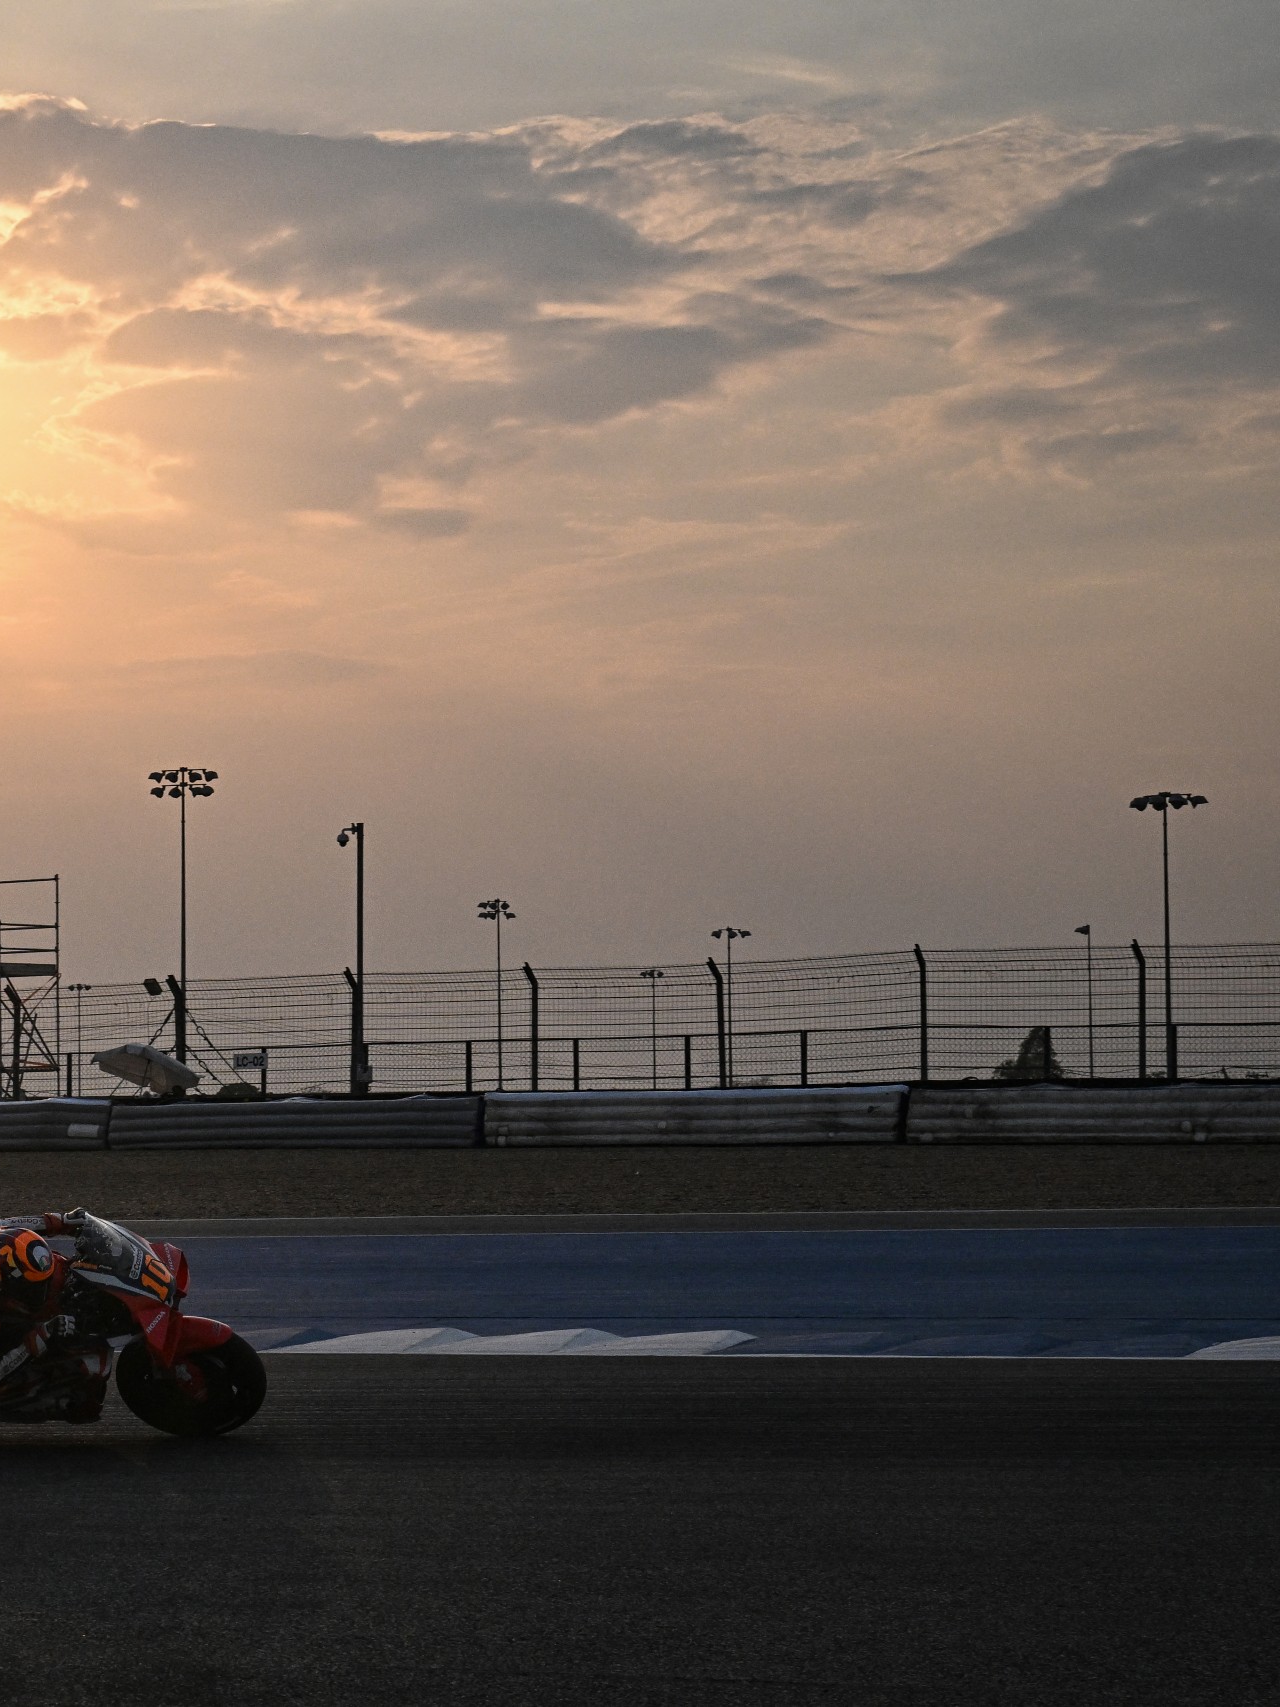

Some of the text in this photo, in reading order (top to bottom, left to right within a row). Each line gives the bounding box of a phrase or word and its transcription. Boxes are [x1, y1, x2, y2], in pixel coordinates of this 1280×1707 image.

[236, 1056, 265, 1067] LC-02
[141, 1254, 171, 1302] 10
[146, 1311, 166, 1334] HONDA
